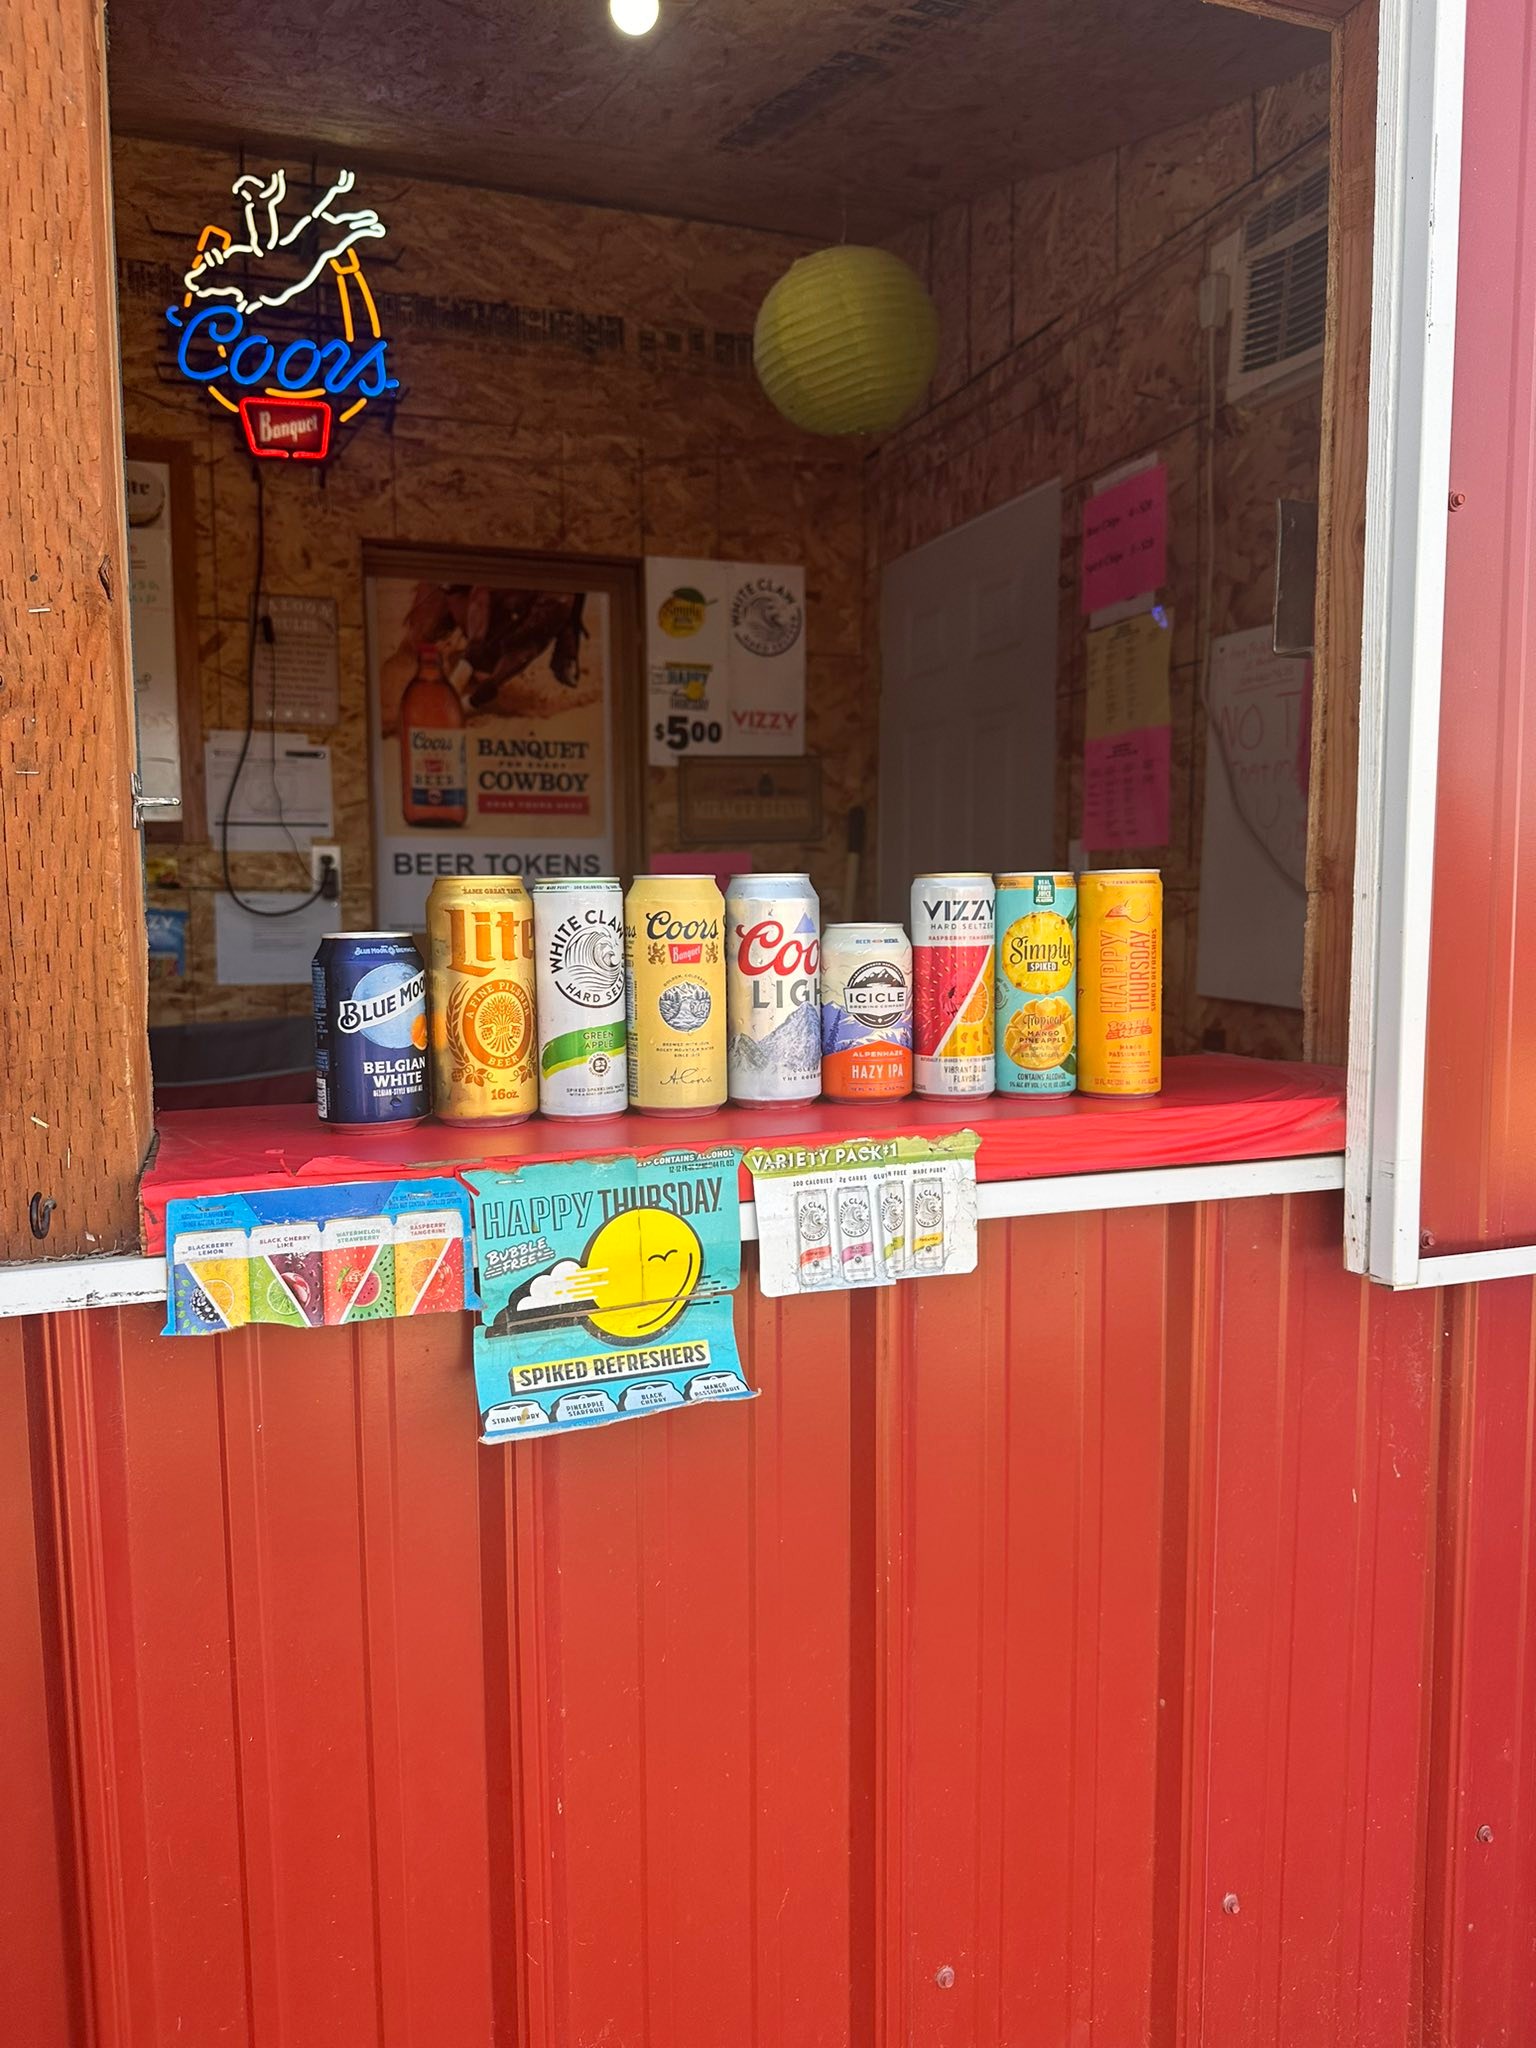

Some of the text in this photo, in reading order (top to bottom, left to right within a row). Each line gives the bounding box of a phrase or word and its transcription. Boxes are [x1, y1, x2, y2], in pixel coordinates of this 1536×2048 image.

[172, 305, 398, 396] Coors
[259, 411, 318, 442] Banquet
[733, 583, 753, 627] WHITE
[757, 578, 795, 604] CLAW
[733, 711, 798, 730] VIZZY
[478, 739, 589, 759] BANQUET
[479, 771, 589, 791] COWBOY
[395, 854, 600, 876] BEER TOKENS
[922, 900, 995, 921] VIZZY
[646, 911, 719, 941] Coors
[444, 909, 534, 977] Lite
[549, 910, 624, 974] WHITE CLAW
[673, 945, 701, 963] Banquet
[1010, 936, 1072, 967] Simply
[1030, 962, 1057, 971] SPIKED
[1100, 930, 1128, 1014] HAPPY
[1129, 930, 1150, 1012] THURSDAY
[469, 986, 494, 1008] FINE
[499, 981, 529, 1016] PILSNER
[566, 983, 601, 1003] HARD
[850, 992, 905, 1004] ICICLE
[340, 994, 397, 1030] BLUE
[1023, 1013, 1063, 1029] Tropical
[583, 1031, 614, 1040] GREEN
[584, 1040, 614, 1050] APPLE
[363, 1056, 426, 1074] BELGIAN
[488, 1054, 520, 1068] BEER
[373, 1071, 422, 1088] WHITE
[852, 1063, 904, 1079] HAZY IPA
[953, 1075, 980, 1083] FLAVORS
[1017, 1073, 1045, 1081] CONTAINS
[653, 1154, 695, 1166] CONTAINS
[696, 1150, 734, 1160] ALCOHOL
[751, 1150, 830, 1170] VARIETY
[805, 1178, 833, 1186] CALORIES
[839, 1176, 846, 1184] 2g
[848, 1175, 867, 1183] CARBS
[839, 1197, 868, 1224] WHITE CLAW
[914, 1189, 941, 1215] WHITE CLAW
[482, 1191, 593, 1240] HAPPY
[799, 1201, 826, 1228] WHITE CLAW
[336, 1229, 381, 1238] WATERMELON
[410, 1222, 447, 1230] RASPBERRY
[188, 1242, 234, 1251] BLACKBERRY
[259, 1235, 311, 1245] BLACK CHERRY
[337, 1235, 380, 1244] STRAWBERRY
[486, 1237, 546, 1265] BUBBLE
[519, 1344, 707, 1388] SPIKED REFRESHERS
[703, 1382, 727, 1390] MANGO
[640, 1397, 667, 1406] CHERRY
[641, 1392, 663, 1400] BLACK
[566, 1401, 604, 1412] PINEAPPLE
[567, 1406, 605, 1417] STARFRUIT
